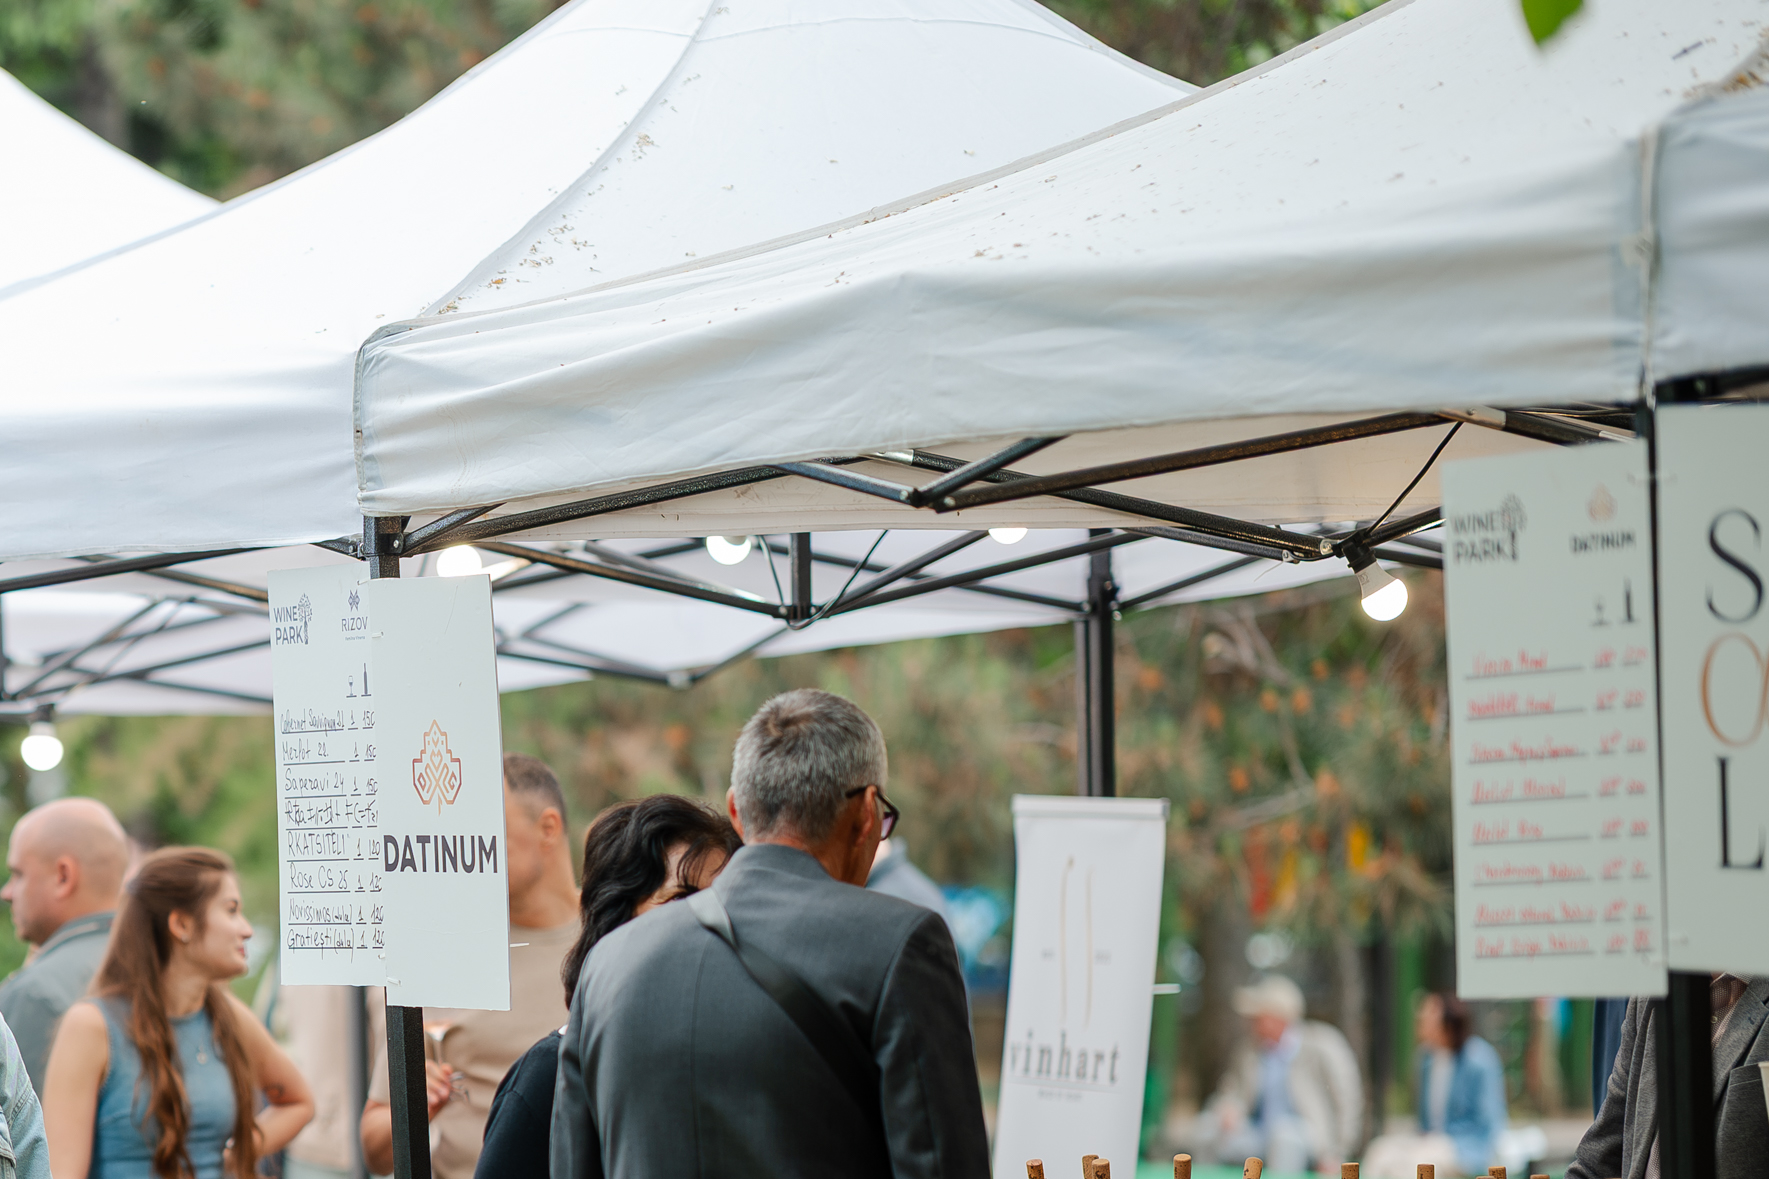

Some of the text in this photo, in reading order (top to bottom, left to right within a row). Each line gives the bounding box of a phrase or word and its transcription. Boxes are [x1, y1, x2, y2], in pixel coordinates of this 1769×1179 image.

[1452, 510, 1499, 534] WINE
[1453, 537, 1509, 566] PARK
[273, 605, 298, 623] WINE
[341, 616, 368, 632] RIZOV
[275, 625, 303, 645] PARK
[282, 738, 311, 762] Merlot
[285, 768, 329, 797] Saperavi
[288, 830, 345, 857] RKATSITELI
[383, 834, 498, 875] DATINUM
[290, 862, 314, 889] Rose
[1010, 1028, 1119, 1085] vinhart
